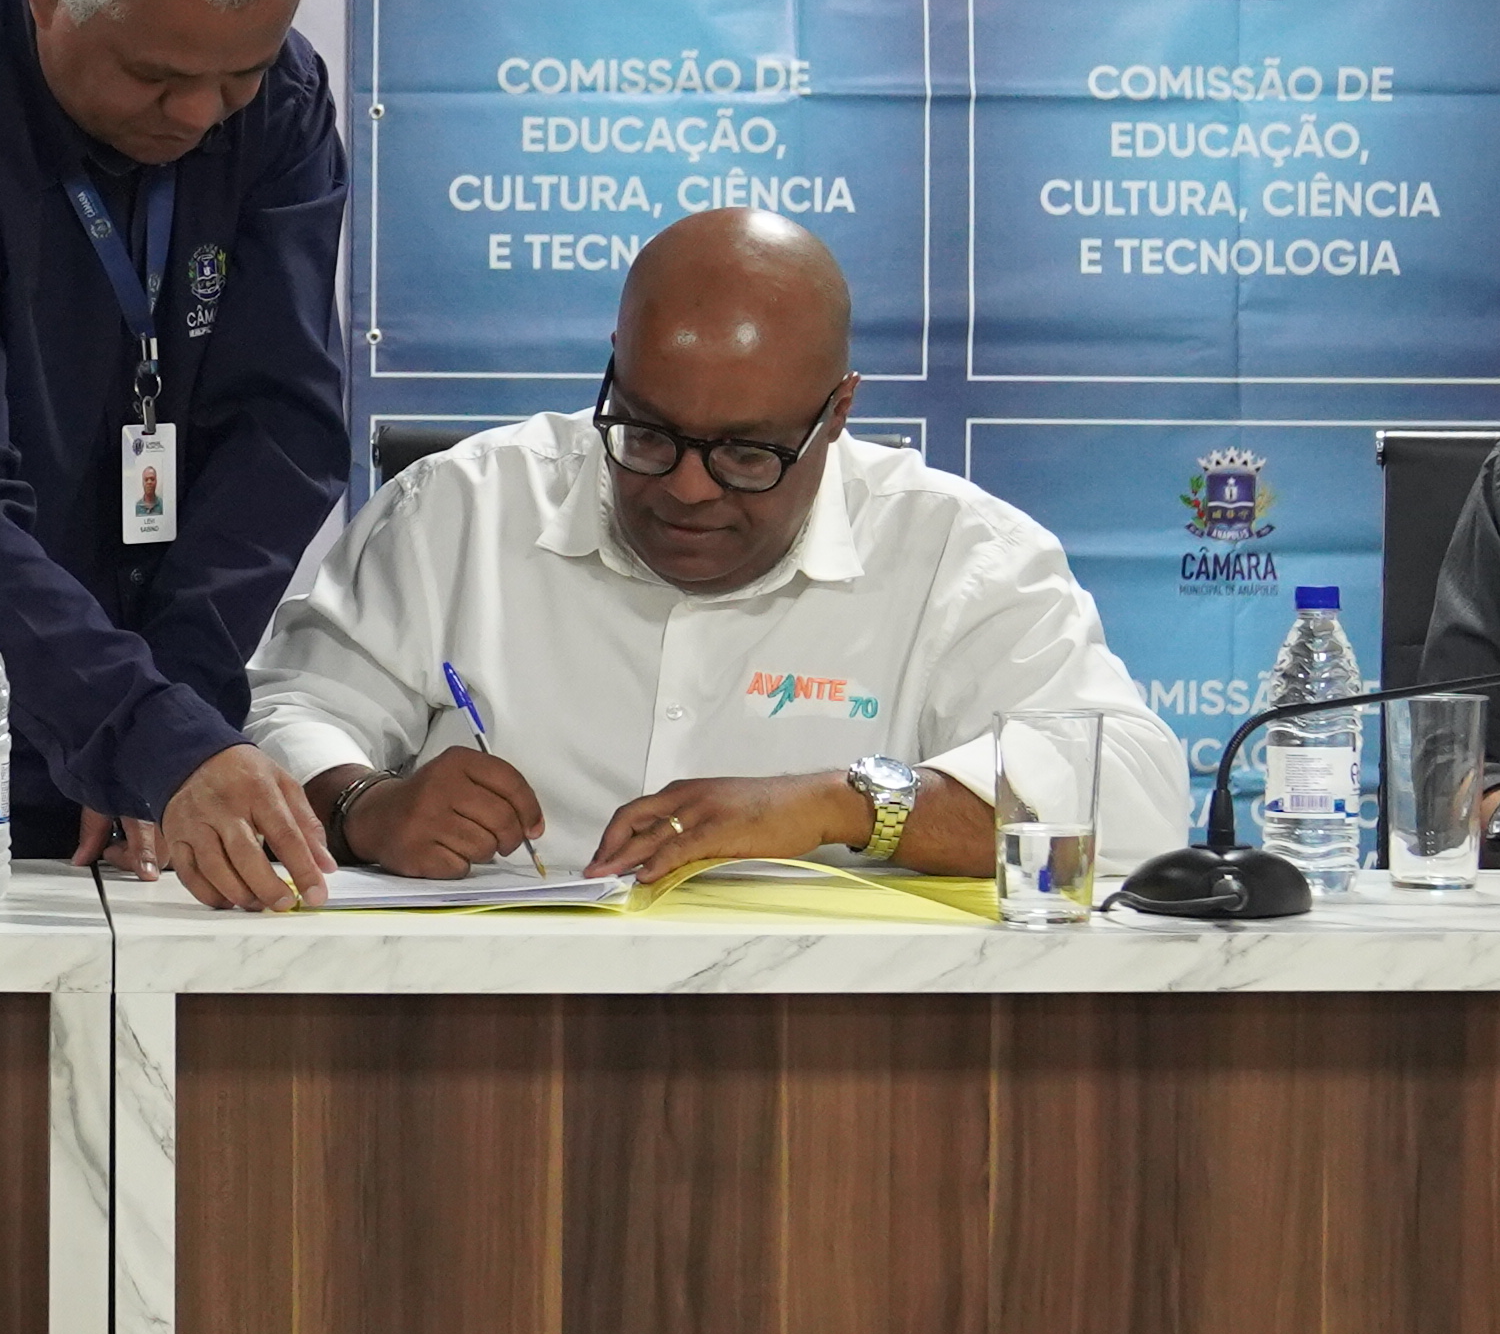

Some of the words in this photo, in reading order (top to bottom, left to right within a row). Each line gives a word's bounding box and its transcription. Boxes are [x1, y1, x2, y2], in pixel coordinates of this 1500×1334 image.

[498, 50, 742, 95] COMISSÃO
[755, 59, 811, 96] DE
[1087, 57, 1323, 102] COMISSÃO
[1336, 66, 1395, 103] DE
[522, 109, 787, 163] EDUCAÇÃO,
[1110, 113, 1369, 167] EDUCAÇÃO,
[448, 174, 663, 218] CULTURA,
[677, 168, 856, 213] CIÊNCIA
[1040, 179, 1248, 223] CULTURA,
[1262, 173, 1441, 218] CIÊNCIA
[488, 233, 512, 270] E
[1079, 238, 1103, 274] E
[1114, 238, 1401, 276] TECNOLOGIA
[1181, 546, 1278, 581] CÂMARA
[746, 671, 848, 717] AVANTE
[848, 696, 879, 719] 70
